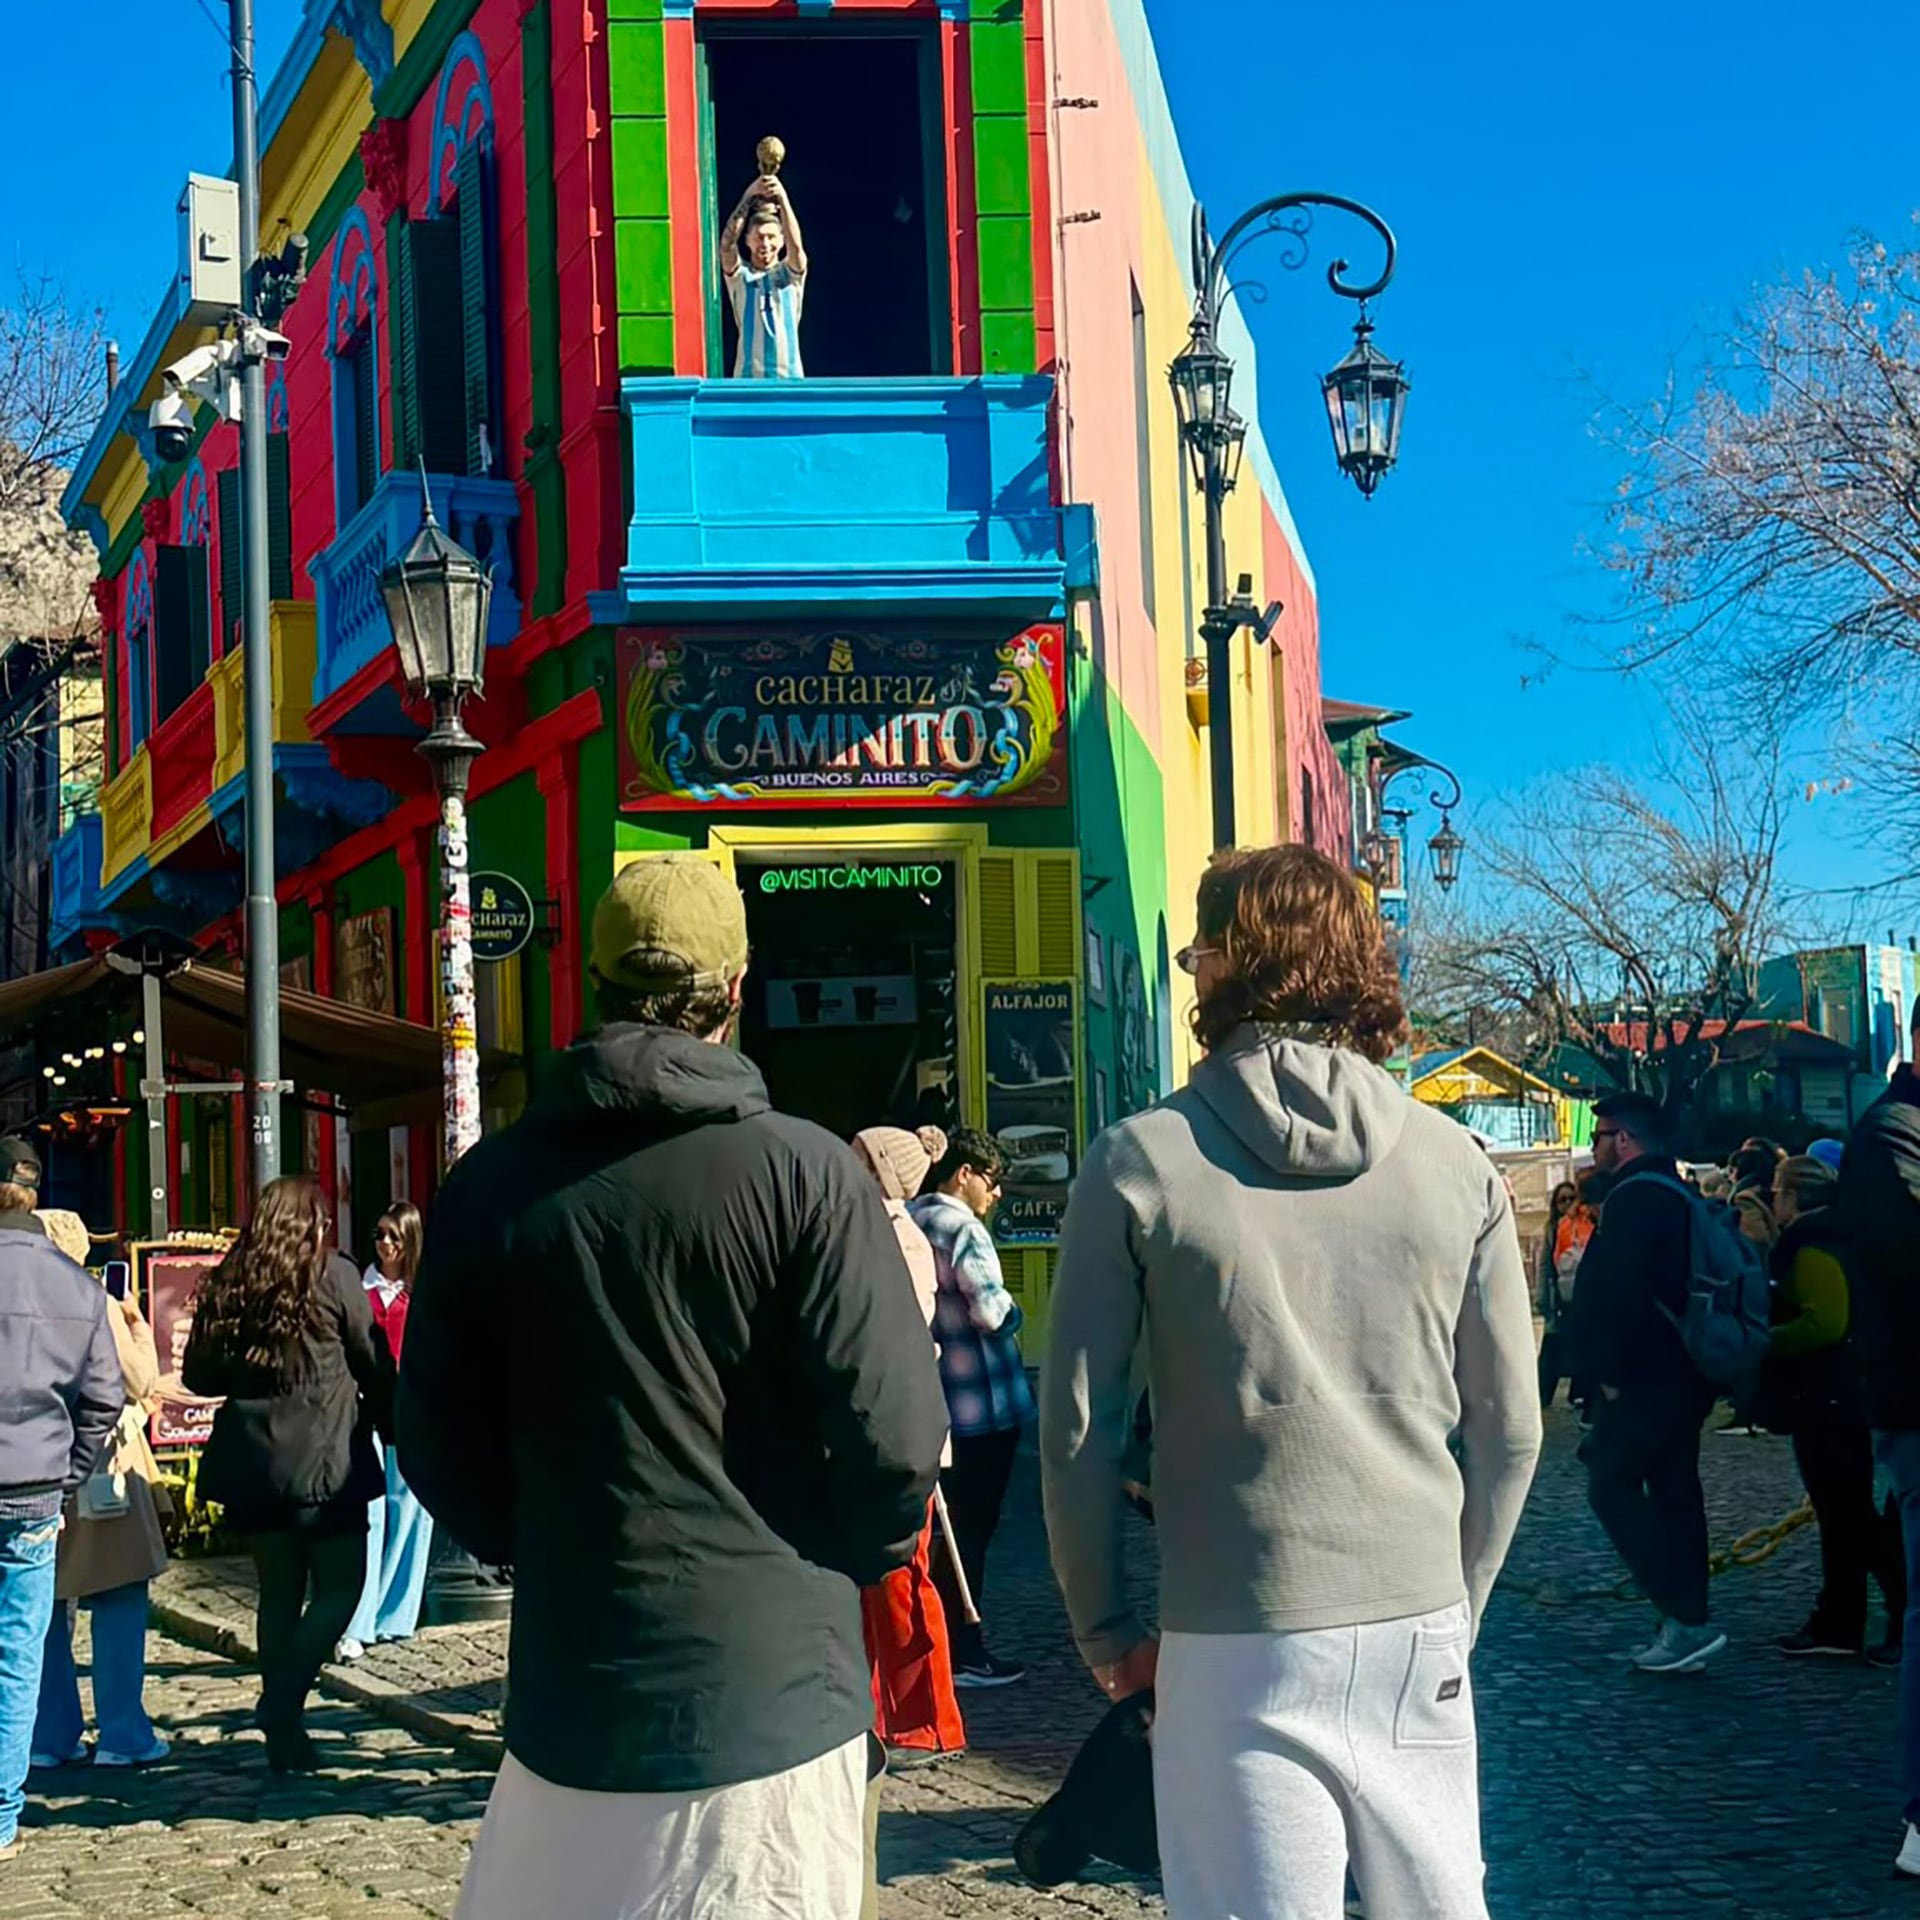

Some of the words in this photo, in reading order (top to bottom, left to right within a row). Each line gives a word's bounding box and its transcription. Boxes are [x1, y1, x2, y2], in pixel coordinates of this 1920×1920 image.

[704, 705, 987, 770] CAMINITO
[773, 772, 853, 786] BUENOS
[859, 771, 919, 786] AIRES
[759, 866, 942, 893] @VISITCAMINITO
[991, 994, 1068, 1010] ALFAJOR
